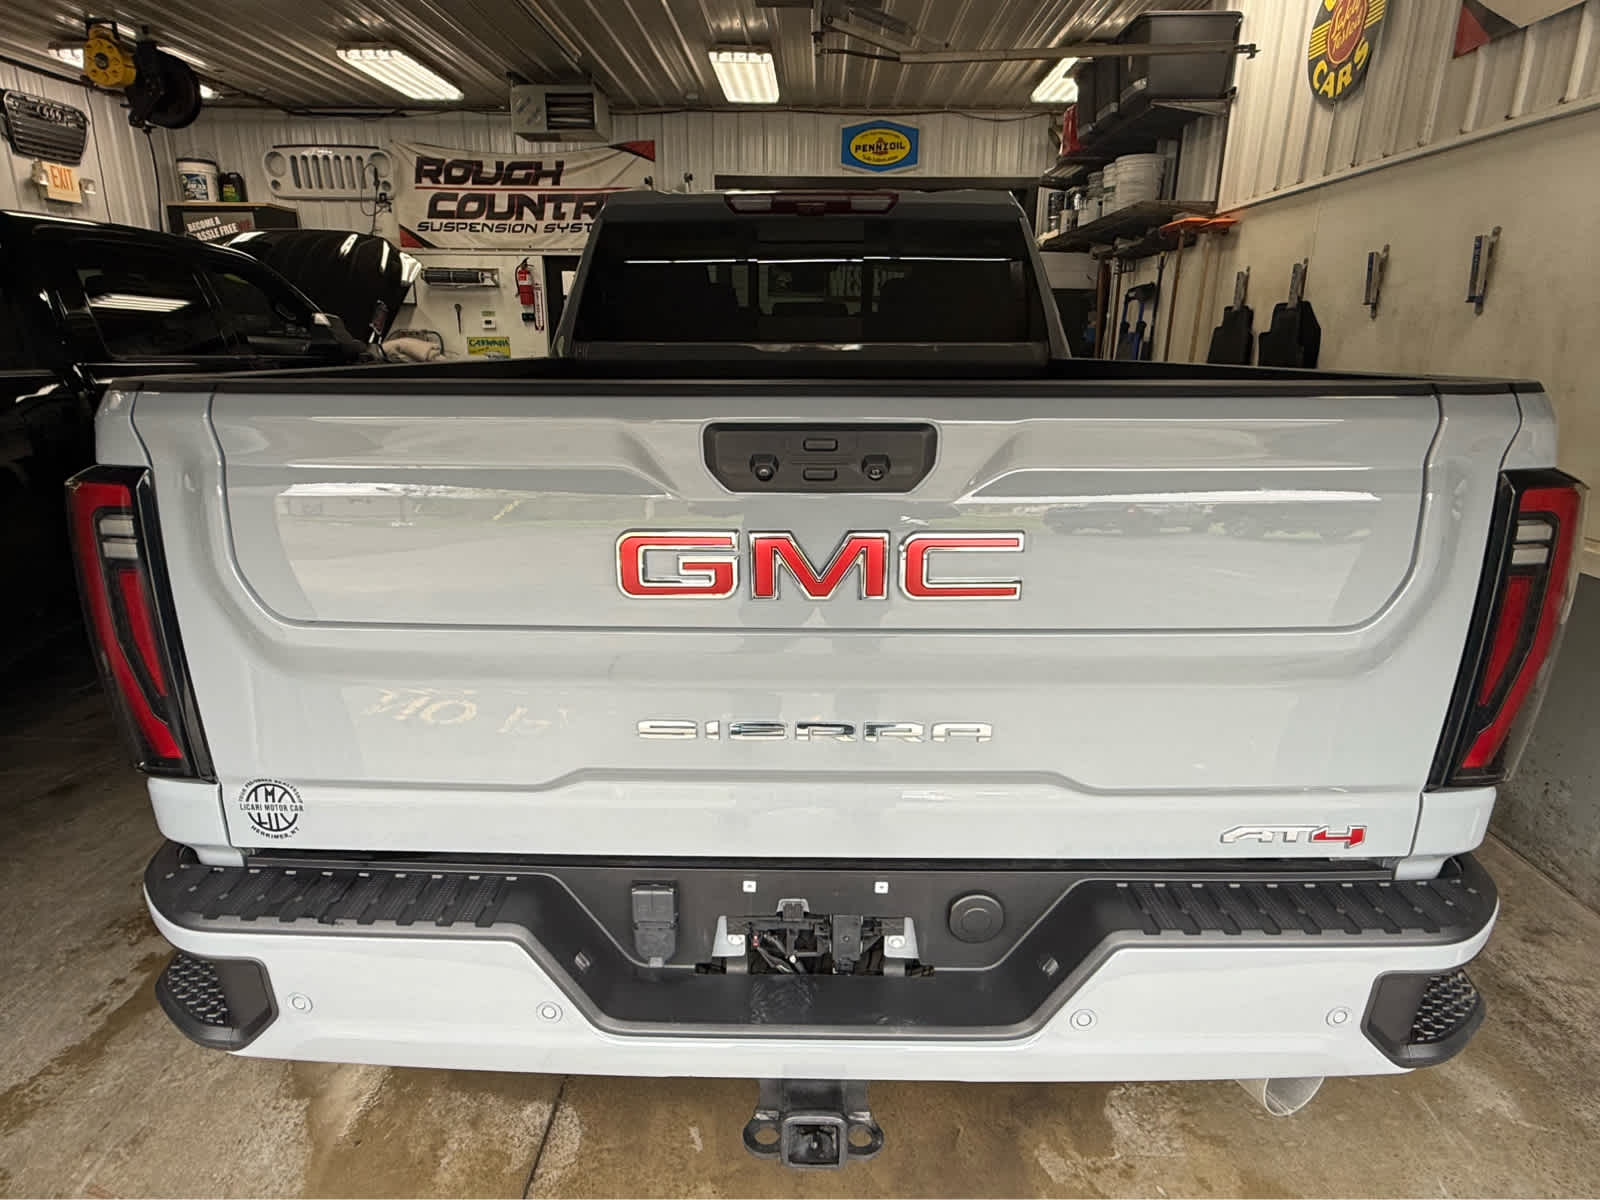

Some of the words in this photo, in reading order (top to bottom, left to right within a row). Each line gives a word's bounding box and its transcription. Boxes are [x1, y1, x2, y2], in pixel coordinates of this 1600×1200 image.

[1312, 36, 1369, 98] CARS
[854, 141, 906, 153] PENNZOIL
[49, 165, 74, 192] EXIT
[415, 156, 565, 186] ROUGH
[427, 192, 608, 221] COUNTR
[186, 217, 215, 233] BECOME
[195, 226, 221, 241] ASSLE
[219, 222, 240, 237] FREE
[417, 221, 538, 234] SUSPENSION
[543, 222, 593, 234] SYST
[614, 528, 1026, 602] GMC
[636, 719, 993, 743] SIERRA
[239, 803, 263, 811] LICARI
[264, 803, 288, 812] MOTOR
[289, 804, 304, 812] CAR
[1220, 824, 1367, 849] AT4
